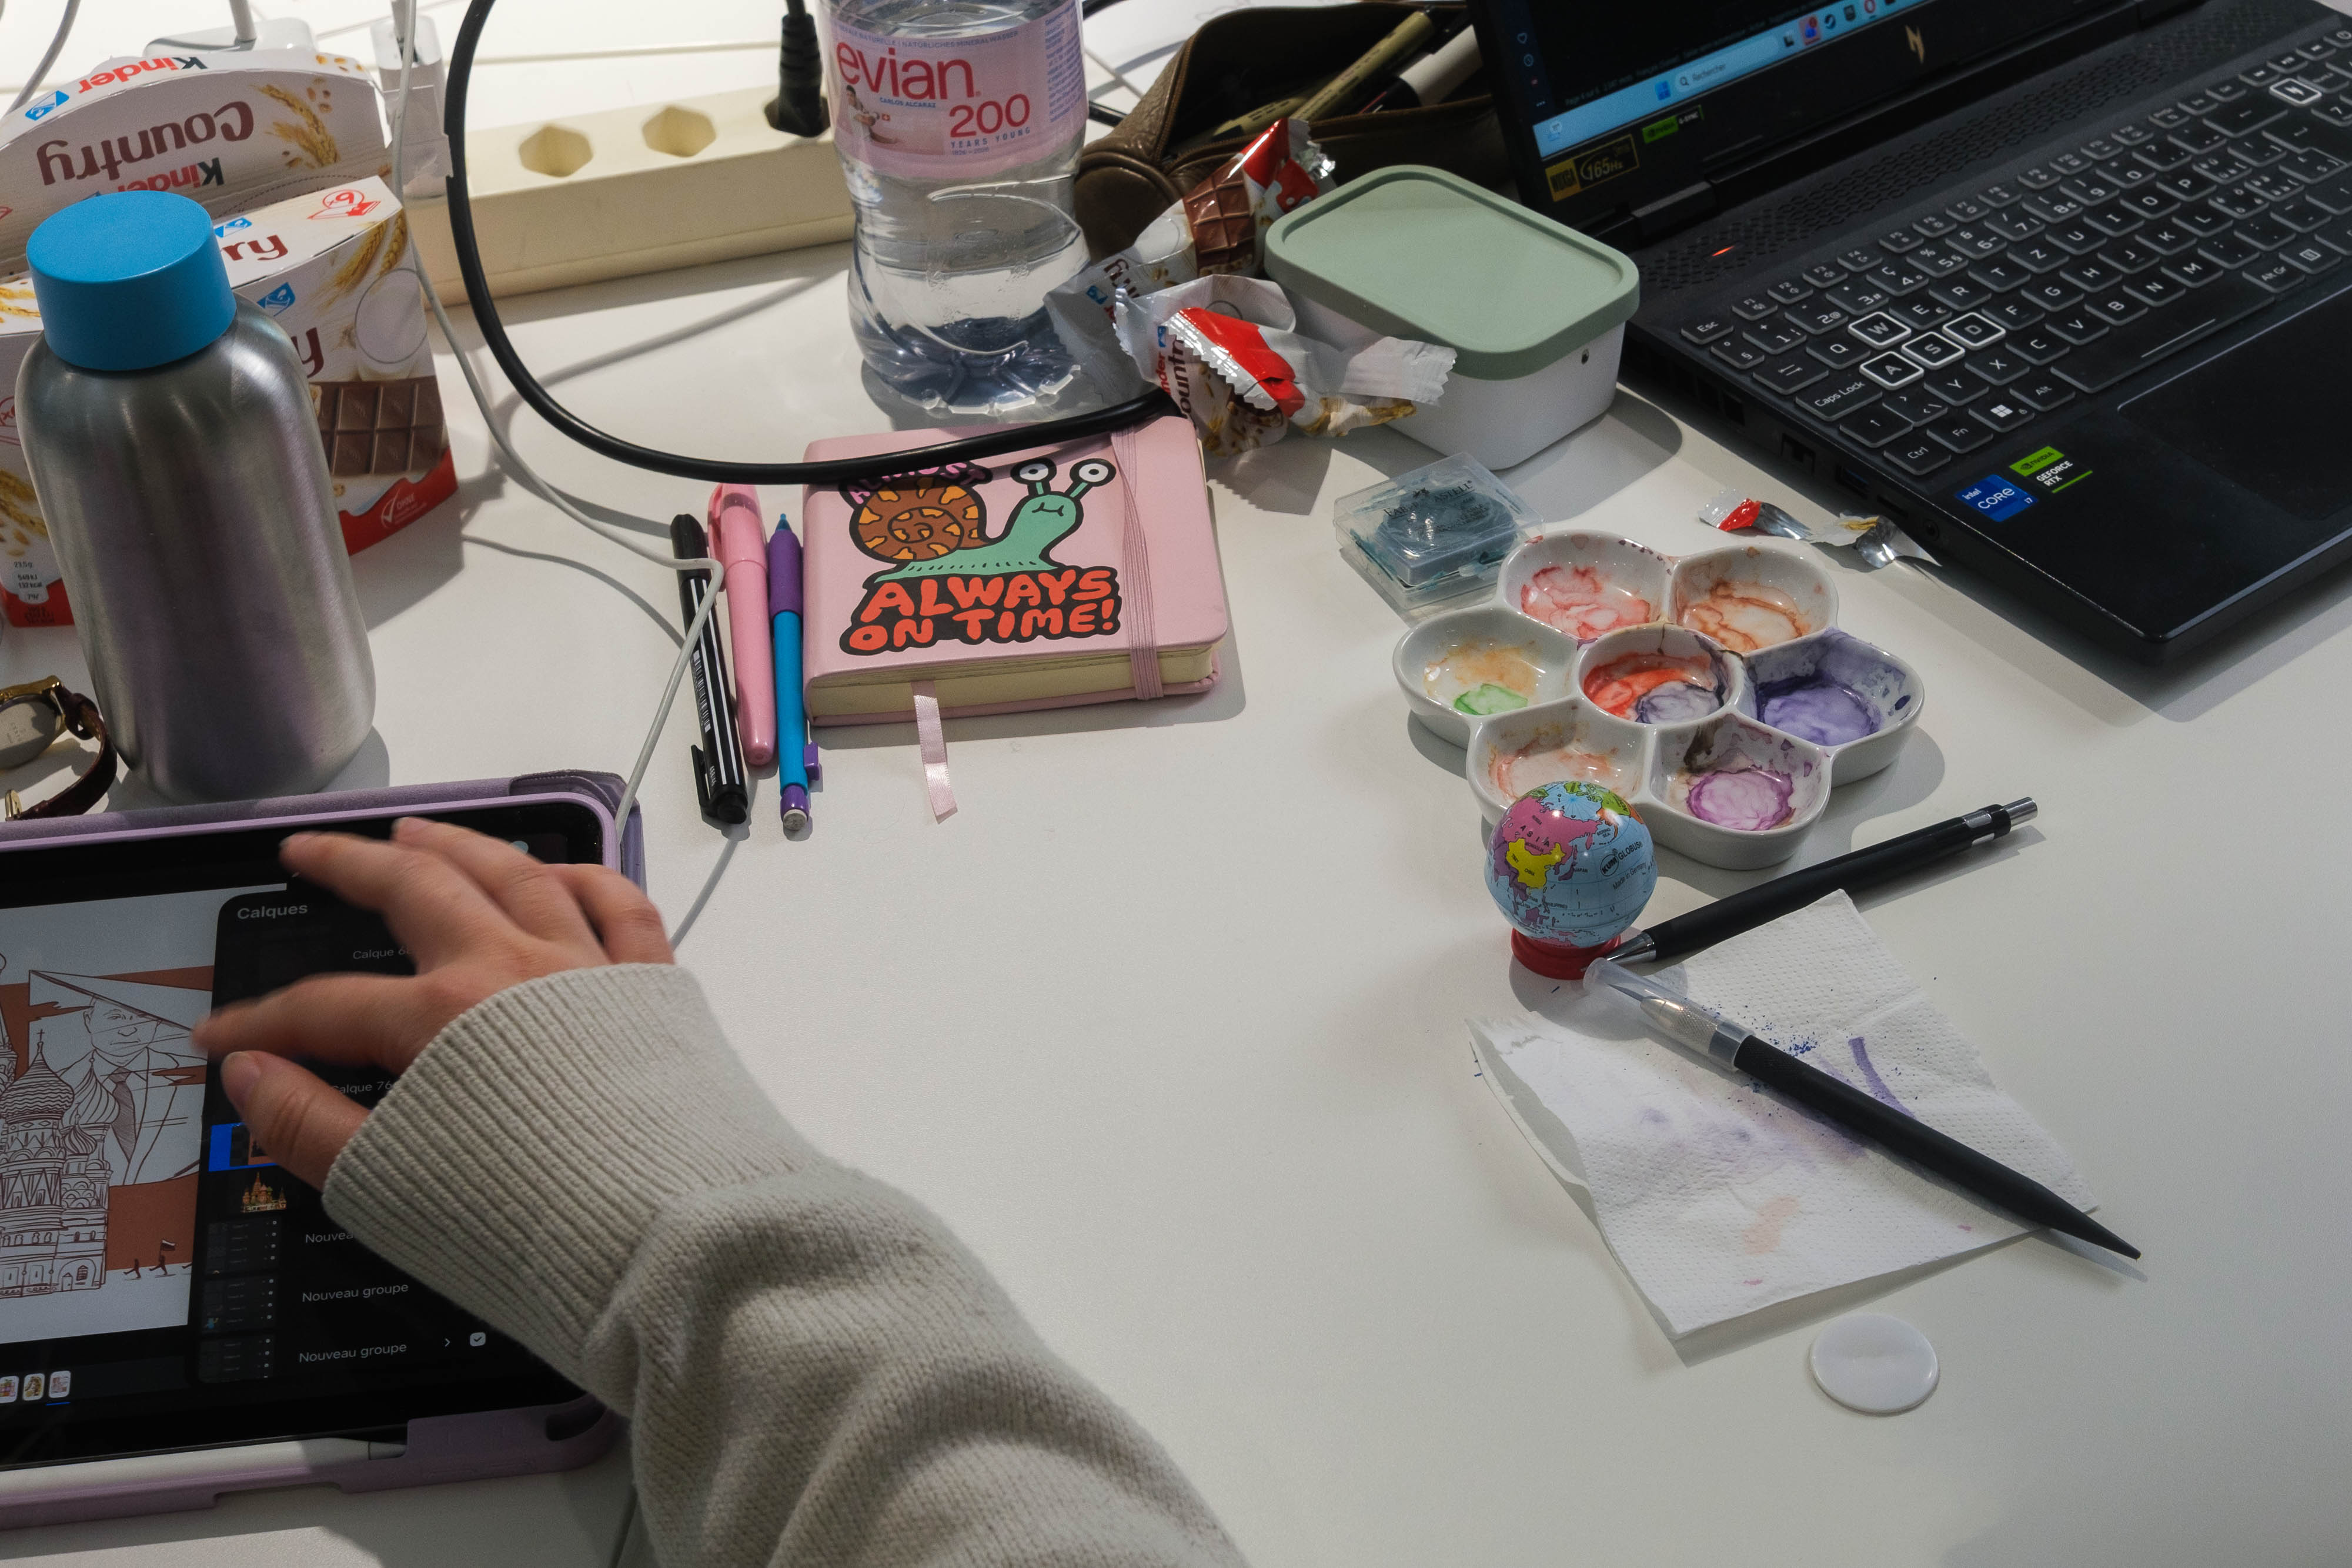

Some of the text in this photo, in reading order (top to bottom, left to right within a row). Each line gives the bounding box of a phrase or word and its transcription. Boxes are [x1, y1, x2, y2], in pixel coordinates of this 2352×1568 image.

[79, 56, 208, 93] Kinder
[836, 42, 975, 101] evian
[879, 97, 937, 109] CARLOS ALCARAZ
[949, 93, 1031, 138] 200
[951, 126, 1031, 148] YEARS YOUNG
[36, 101, 254, 186] Country
[2142, 196, 2159, 206] O
[2194, 215, 2211, 223] L
[2067, 230, 2084, 240] U
[2157, 231, 2176, 241] K
[2029, 249, 2047, 259] Z
[2124, 250, 2136, 260] J
[1990, 267, 2006, 276] T
[2082, 268, 2100, 278] H
[2182, 262, 2203, 275] M
[1952, 286, 1969, 296] R
[2044, 286, 2061, 296] G
[2145, 282, 2164, 293] N
[1912, 304, 1929, 315] E
[2006, 305, 2017, 315] F
[2107, 300, 2126, 311] B
[1697, 322, 1718, 332] Esc
[1867, 322, 1890, 335] W
[2067, 319, 2084, 329] V
[1964, 325, 1982, 335] D
[1830, 344, 1849, 353] Q
[1924, 343, 1942, 354] S
[2030, 339, 2047, 349] C
[1989, 359, 2007, 370] X
[1155, 352, 1171, 396] nder
[1885, 365, 1902, 376] A
[1168, 340, 1192, 419] ountr
[1947, 379, 1962, 389] Y
[1815, 382, 1866, 407] Caps Lock
[2035, 386, 2053, 396] Alt
[1952, 427, 1969, 437] Fn
[1907, 446, 1929, 459] Ctrl
[2036, 460, 2074, 482] GEFORCE
[847, 462, 986, 504] ALST
[2043, 476, 2063, 487] RTX
[1962, 488, 1982, 501] intel
[860, 569, 1112, 623] ALWAYS
[849, 599, 1115, 651] ON TIME!
[1520, 824, 1550, 848] ASIA
[1601, 857, 1618, 874] KUM
[1612, 876, 1626, 890] Made
[1629, 862, 1647, 875] Germany
[237, 902, 308, 921] Calques
[353, 949, 395, 960] Calque
[305, 1230, 354, 1243] Nouvea
[302, 1283, 409, 1303] Nouveau groupe
[299, 1342, 407, 1363] Nouveau groupe
